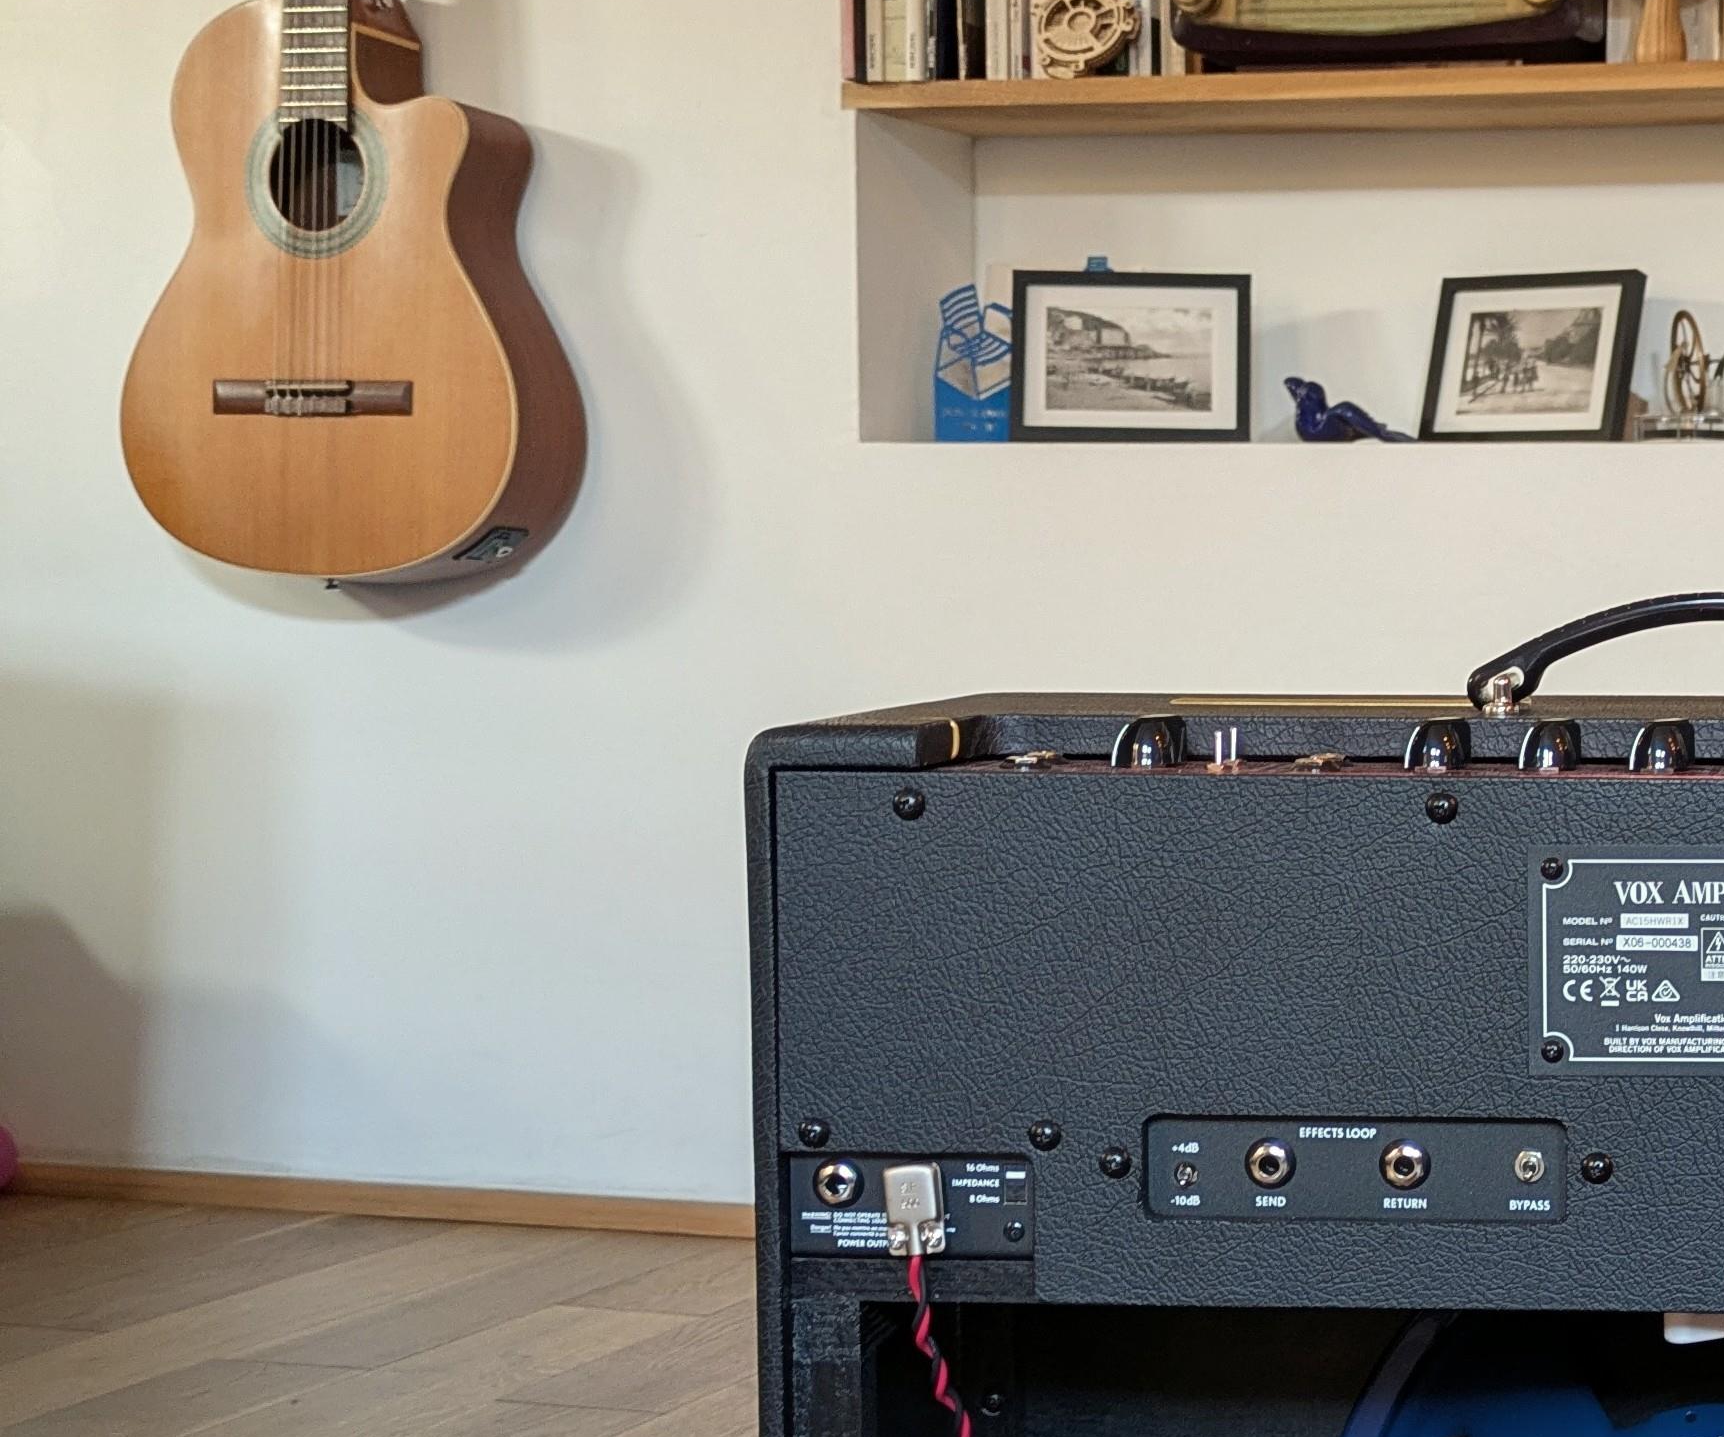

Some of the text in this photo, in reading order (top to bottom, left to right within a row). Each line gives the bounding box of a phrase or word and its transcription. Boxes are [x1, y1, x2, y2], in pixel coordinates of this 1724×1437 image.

[1613, 881, 1664, 905] VOX
[1562, 917, 1598, 926] MODEL
[1562, 938, 1599, 946] SERIAL
[1562, 964, 1648, 974] 50/60Hz 140W
[1654, 1014, 1671, 1023] Vox
[1603, 1037, 1627, 1045] BUILT
[1628, 1037, 1640, 1045] BY
[1641, 1037, 1657, 1045] VOX
[1608, 1045, 1652, 1053] DIRECTION
[1653, 1045, 1665, 1053] OF
[1666, 1045, 1682, 1053] VOX
[1299, 1127, 1377, 1140] EFFECTS LOOP
[1171, 1143, 1199, 1154] +4dB
[966, 1163, 1000, 1172] 16 Ohms
[951, 1179, 1000, 1187] IMPEDANCE
[969, 1195, 1000, 1204] 8 Ohms
[1170, 1195, 1200, 1206] -10dB
[1255, 1196, 1286, 1208] SEND
[1383, 1198, 1427, 1210] RETURN
[1509, 1200, 1551, 1212] BYPASS
[837, 1239, 890, 1248] POWER OUTP
